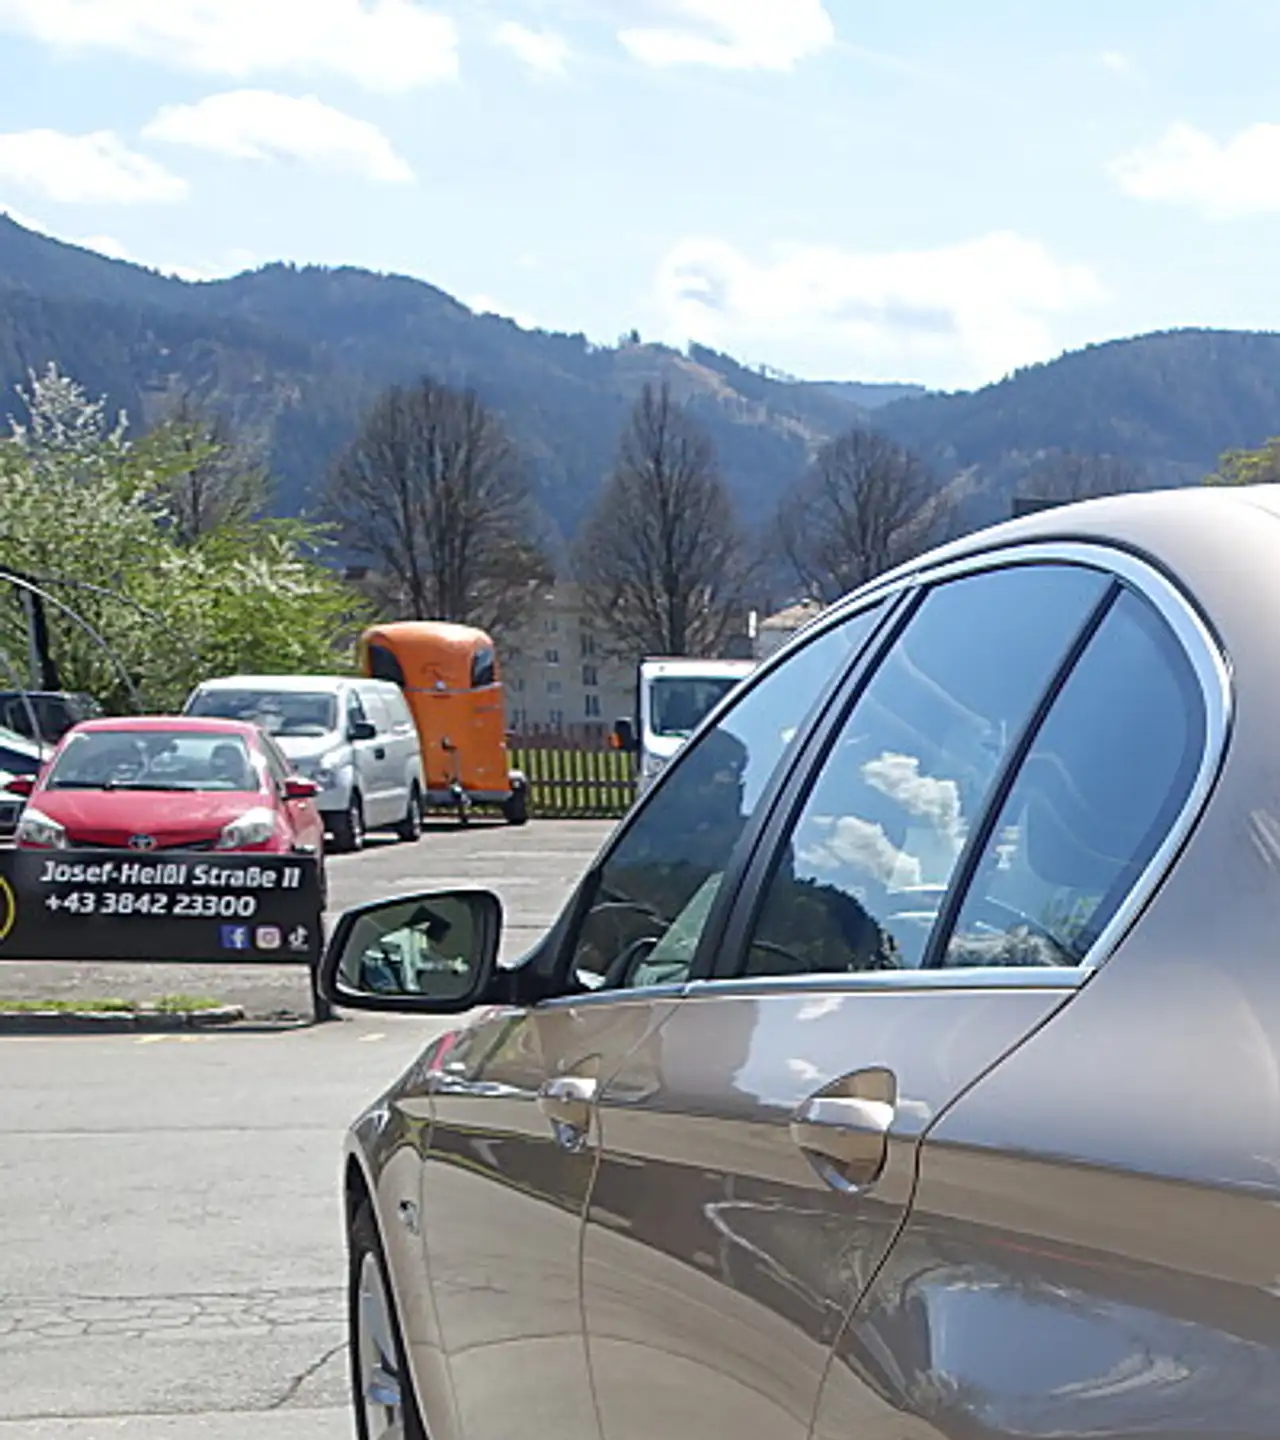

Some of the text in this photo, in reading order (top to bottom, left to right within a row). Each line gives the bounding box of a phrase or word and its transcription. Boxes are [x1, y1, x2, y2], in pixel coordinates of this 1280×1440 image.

[40, 860, 186, 885] Josef-Heißl
[191, 866, 276, 889] Straße
[44, 892, 257, 917] +43 3842 23300
